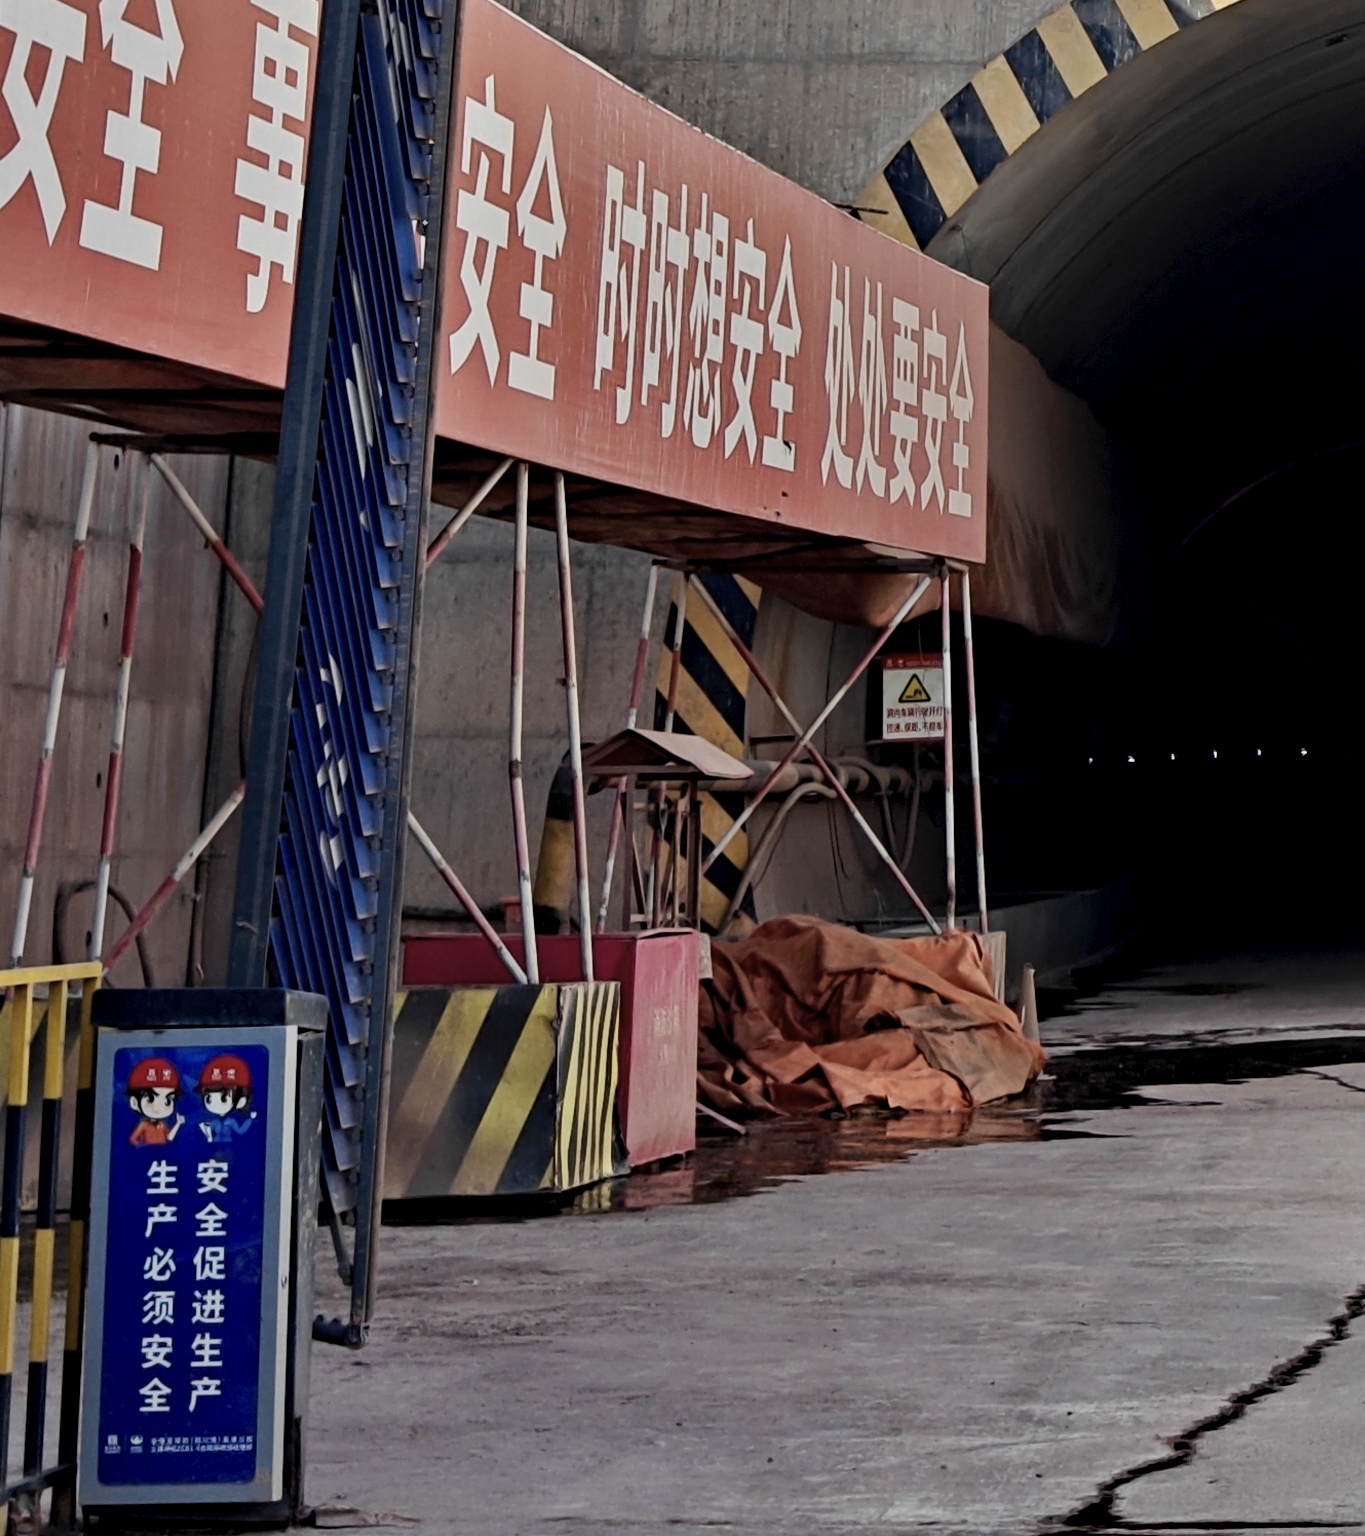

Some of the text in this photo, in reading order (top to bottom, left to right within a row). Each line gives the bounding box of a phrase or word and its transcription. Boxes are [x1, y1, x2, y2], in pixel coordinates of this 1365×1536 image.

[593, 159, 802, 473] 时时想安全
[820, 258, 975, 518] 处处要安全
[138, 1159, 180, 1415] 生产必须安全
[188, 1159, 229, 1414] 安全促进生产
